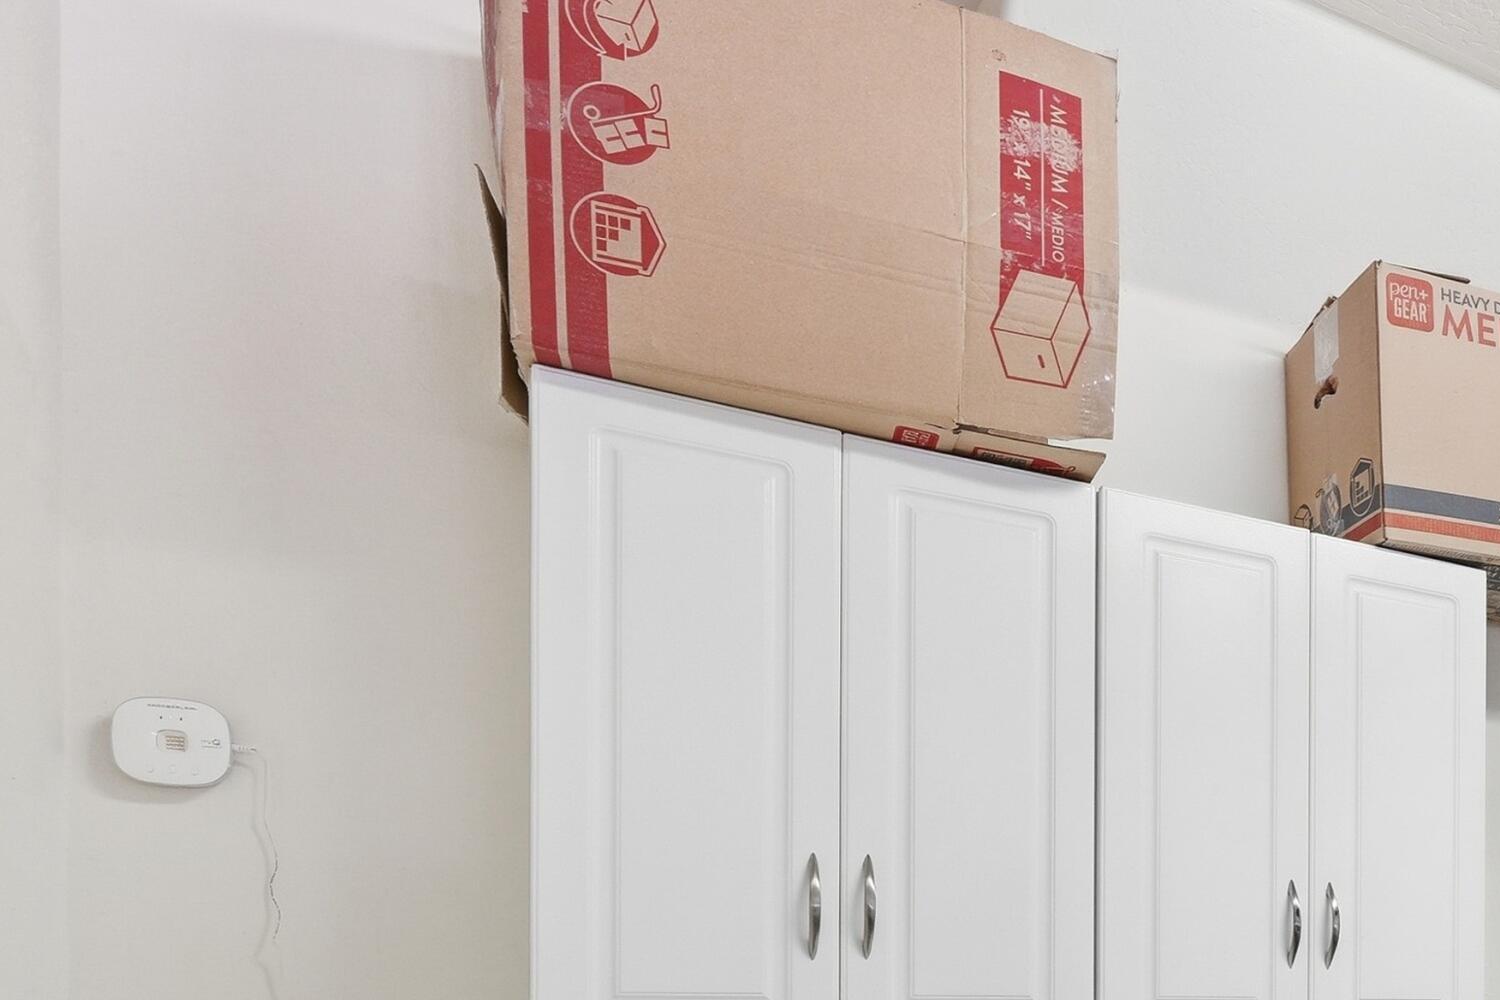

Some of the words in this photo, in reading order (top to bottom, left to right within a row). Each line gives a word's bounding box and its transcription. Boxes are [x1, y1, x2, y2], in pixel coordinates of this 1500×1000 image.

[1012, 159, 1032, 191] 14"
[1013, 193, 1026, 207] x
[1013, 212, 1032, 240] 17"
[1051, 212, 1065, 263] MEDIO
[1389, 281, 1429, 301] pen+
[1440, 287, 1490, 312] HEAVY
[1393, 298, 1428, 324] GEAR
